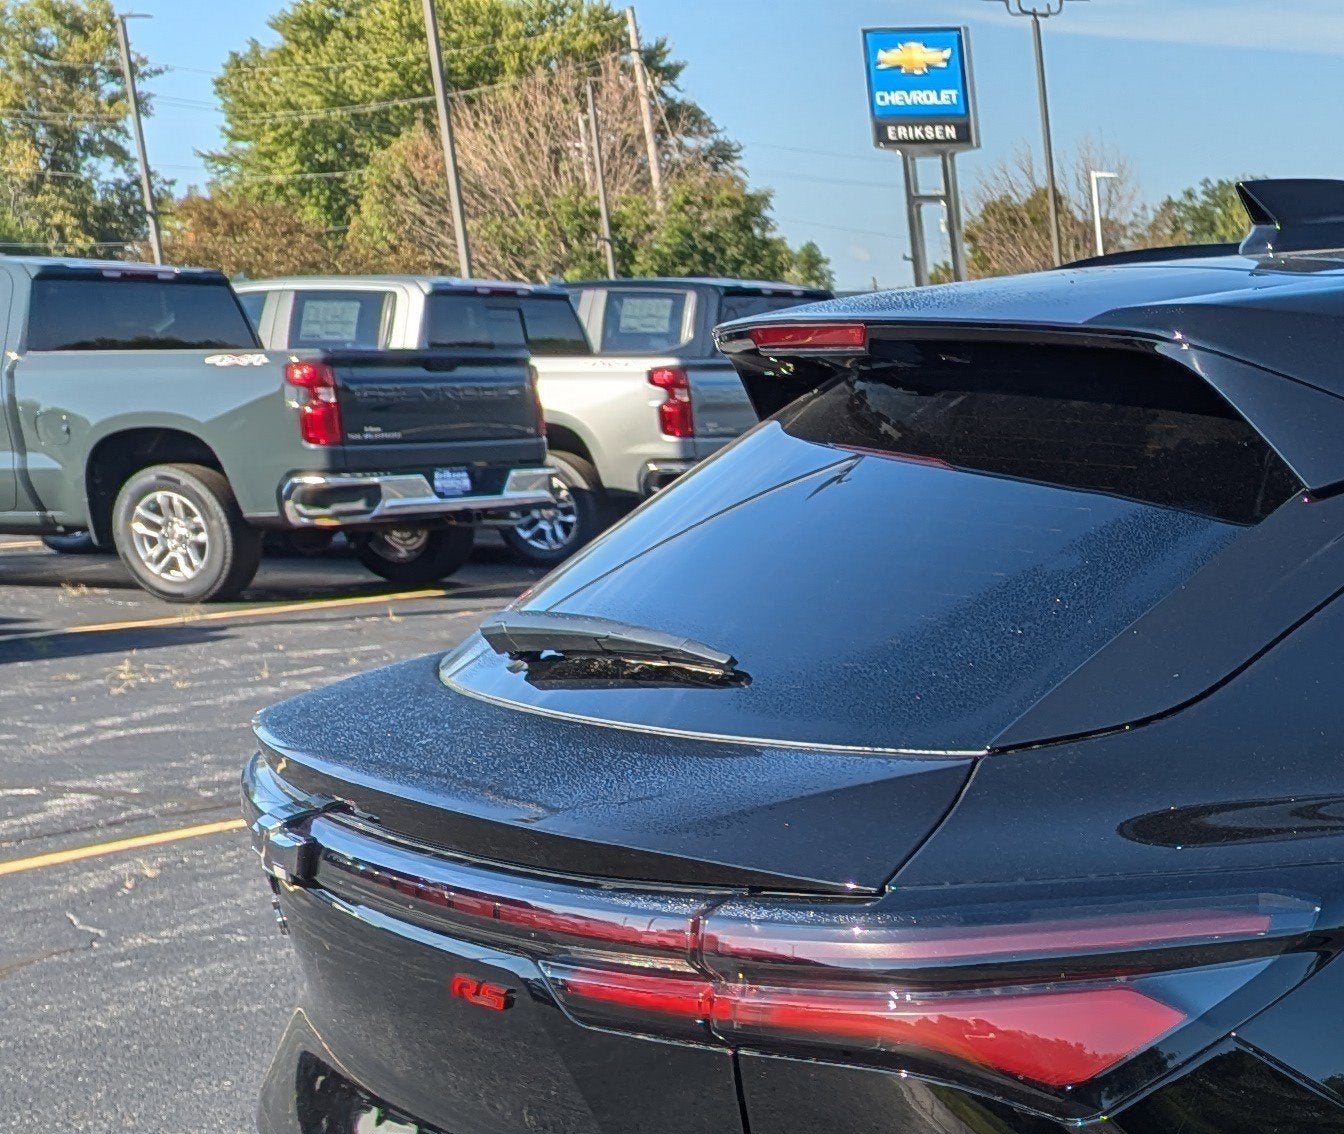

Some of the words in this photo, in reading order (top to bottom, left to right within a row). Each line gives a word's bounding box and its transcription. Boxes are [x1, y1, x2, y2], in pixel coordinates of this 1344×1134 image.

[875, 89, 958, 106] CHEVROLET
[886, 125, 957, 140] ERIKSEN
[450, 973, 508, 1012] RS
